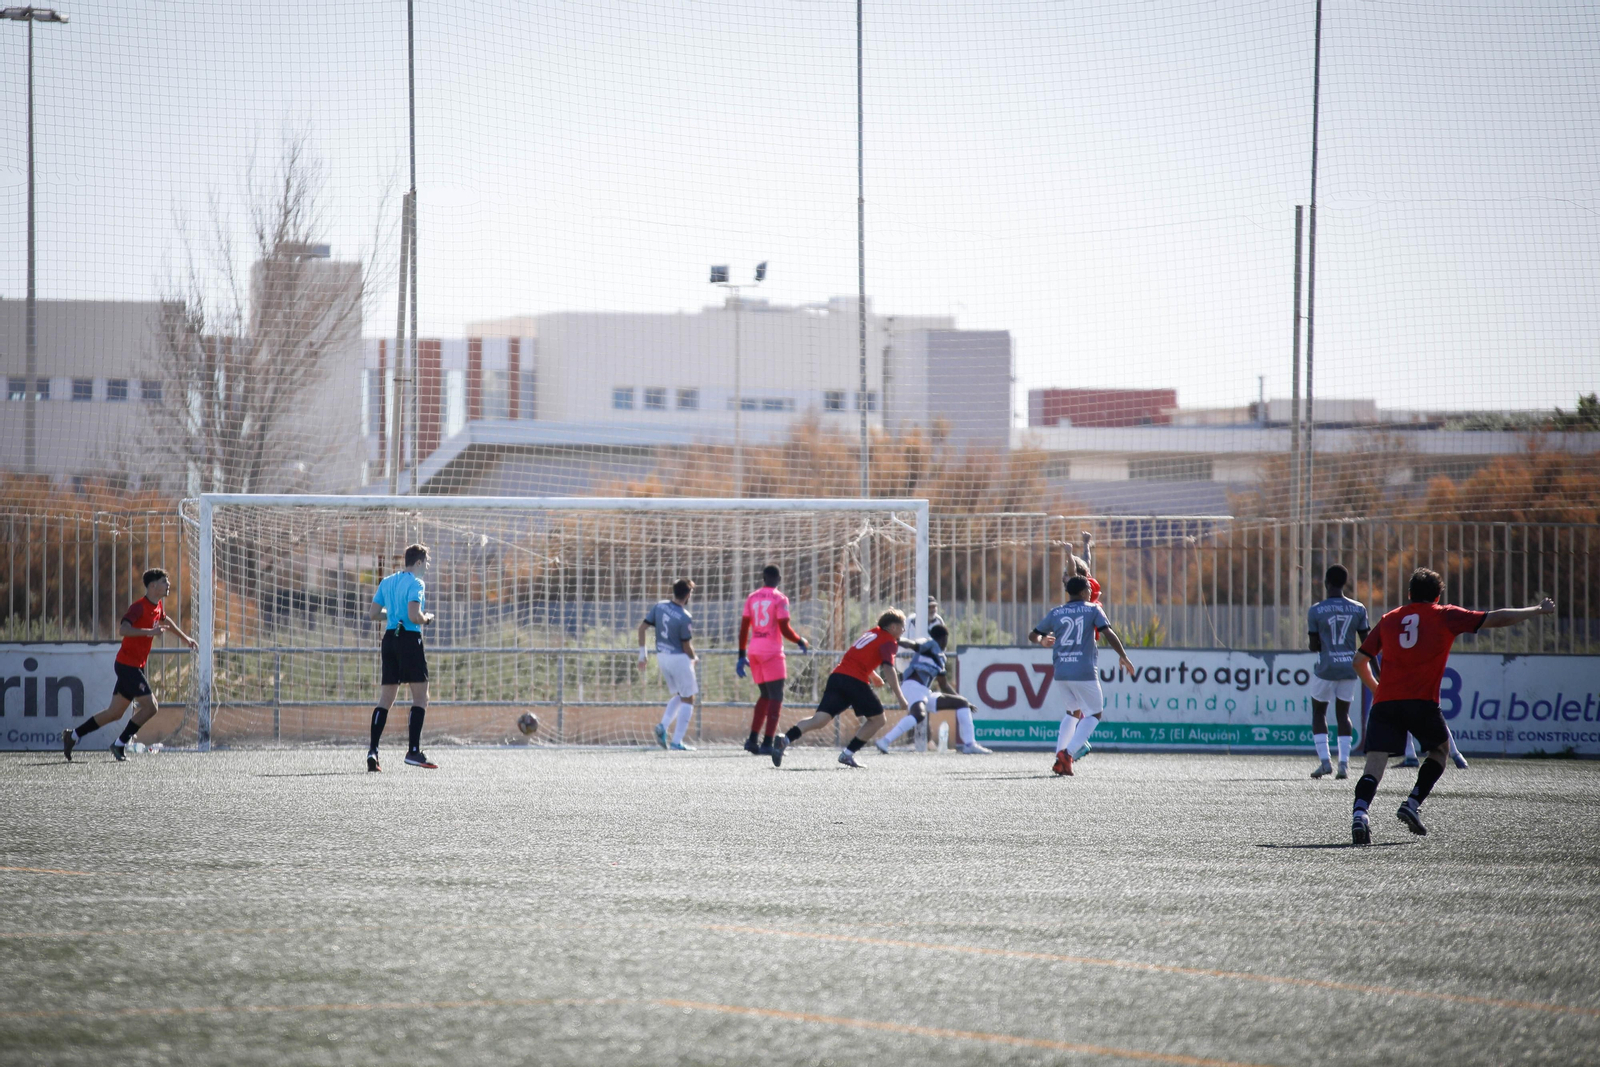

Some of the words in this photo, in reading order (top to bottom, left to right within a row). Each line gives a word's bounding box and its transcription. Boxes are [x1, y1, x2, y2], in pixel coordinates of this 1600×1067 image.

[660, 612, 671, 639] 5
[752, 600, 771, 627] 13
[853, 631, 878, 650] 10
[1060, 615, 1084, 646] 21
[1327, 614, 1353, 645] 17
[1399, 613, 1420, 649] 3
[1100, 660, 1208, 684] uivarto
[1254, 695, 1308, 715] junt
[974, 726, 1025, 738] arretera
[1121, 727, 1145, 739] Km.
[1149, 728, 1165, 741] 7,5
[1170, 728, 1185, 742] (El
[1272, 731, 1296, 741] 950
[1496, 730, 1515, 742] DE
